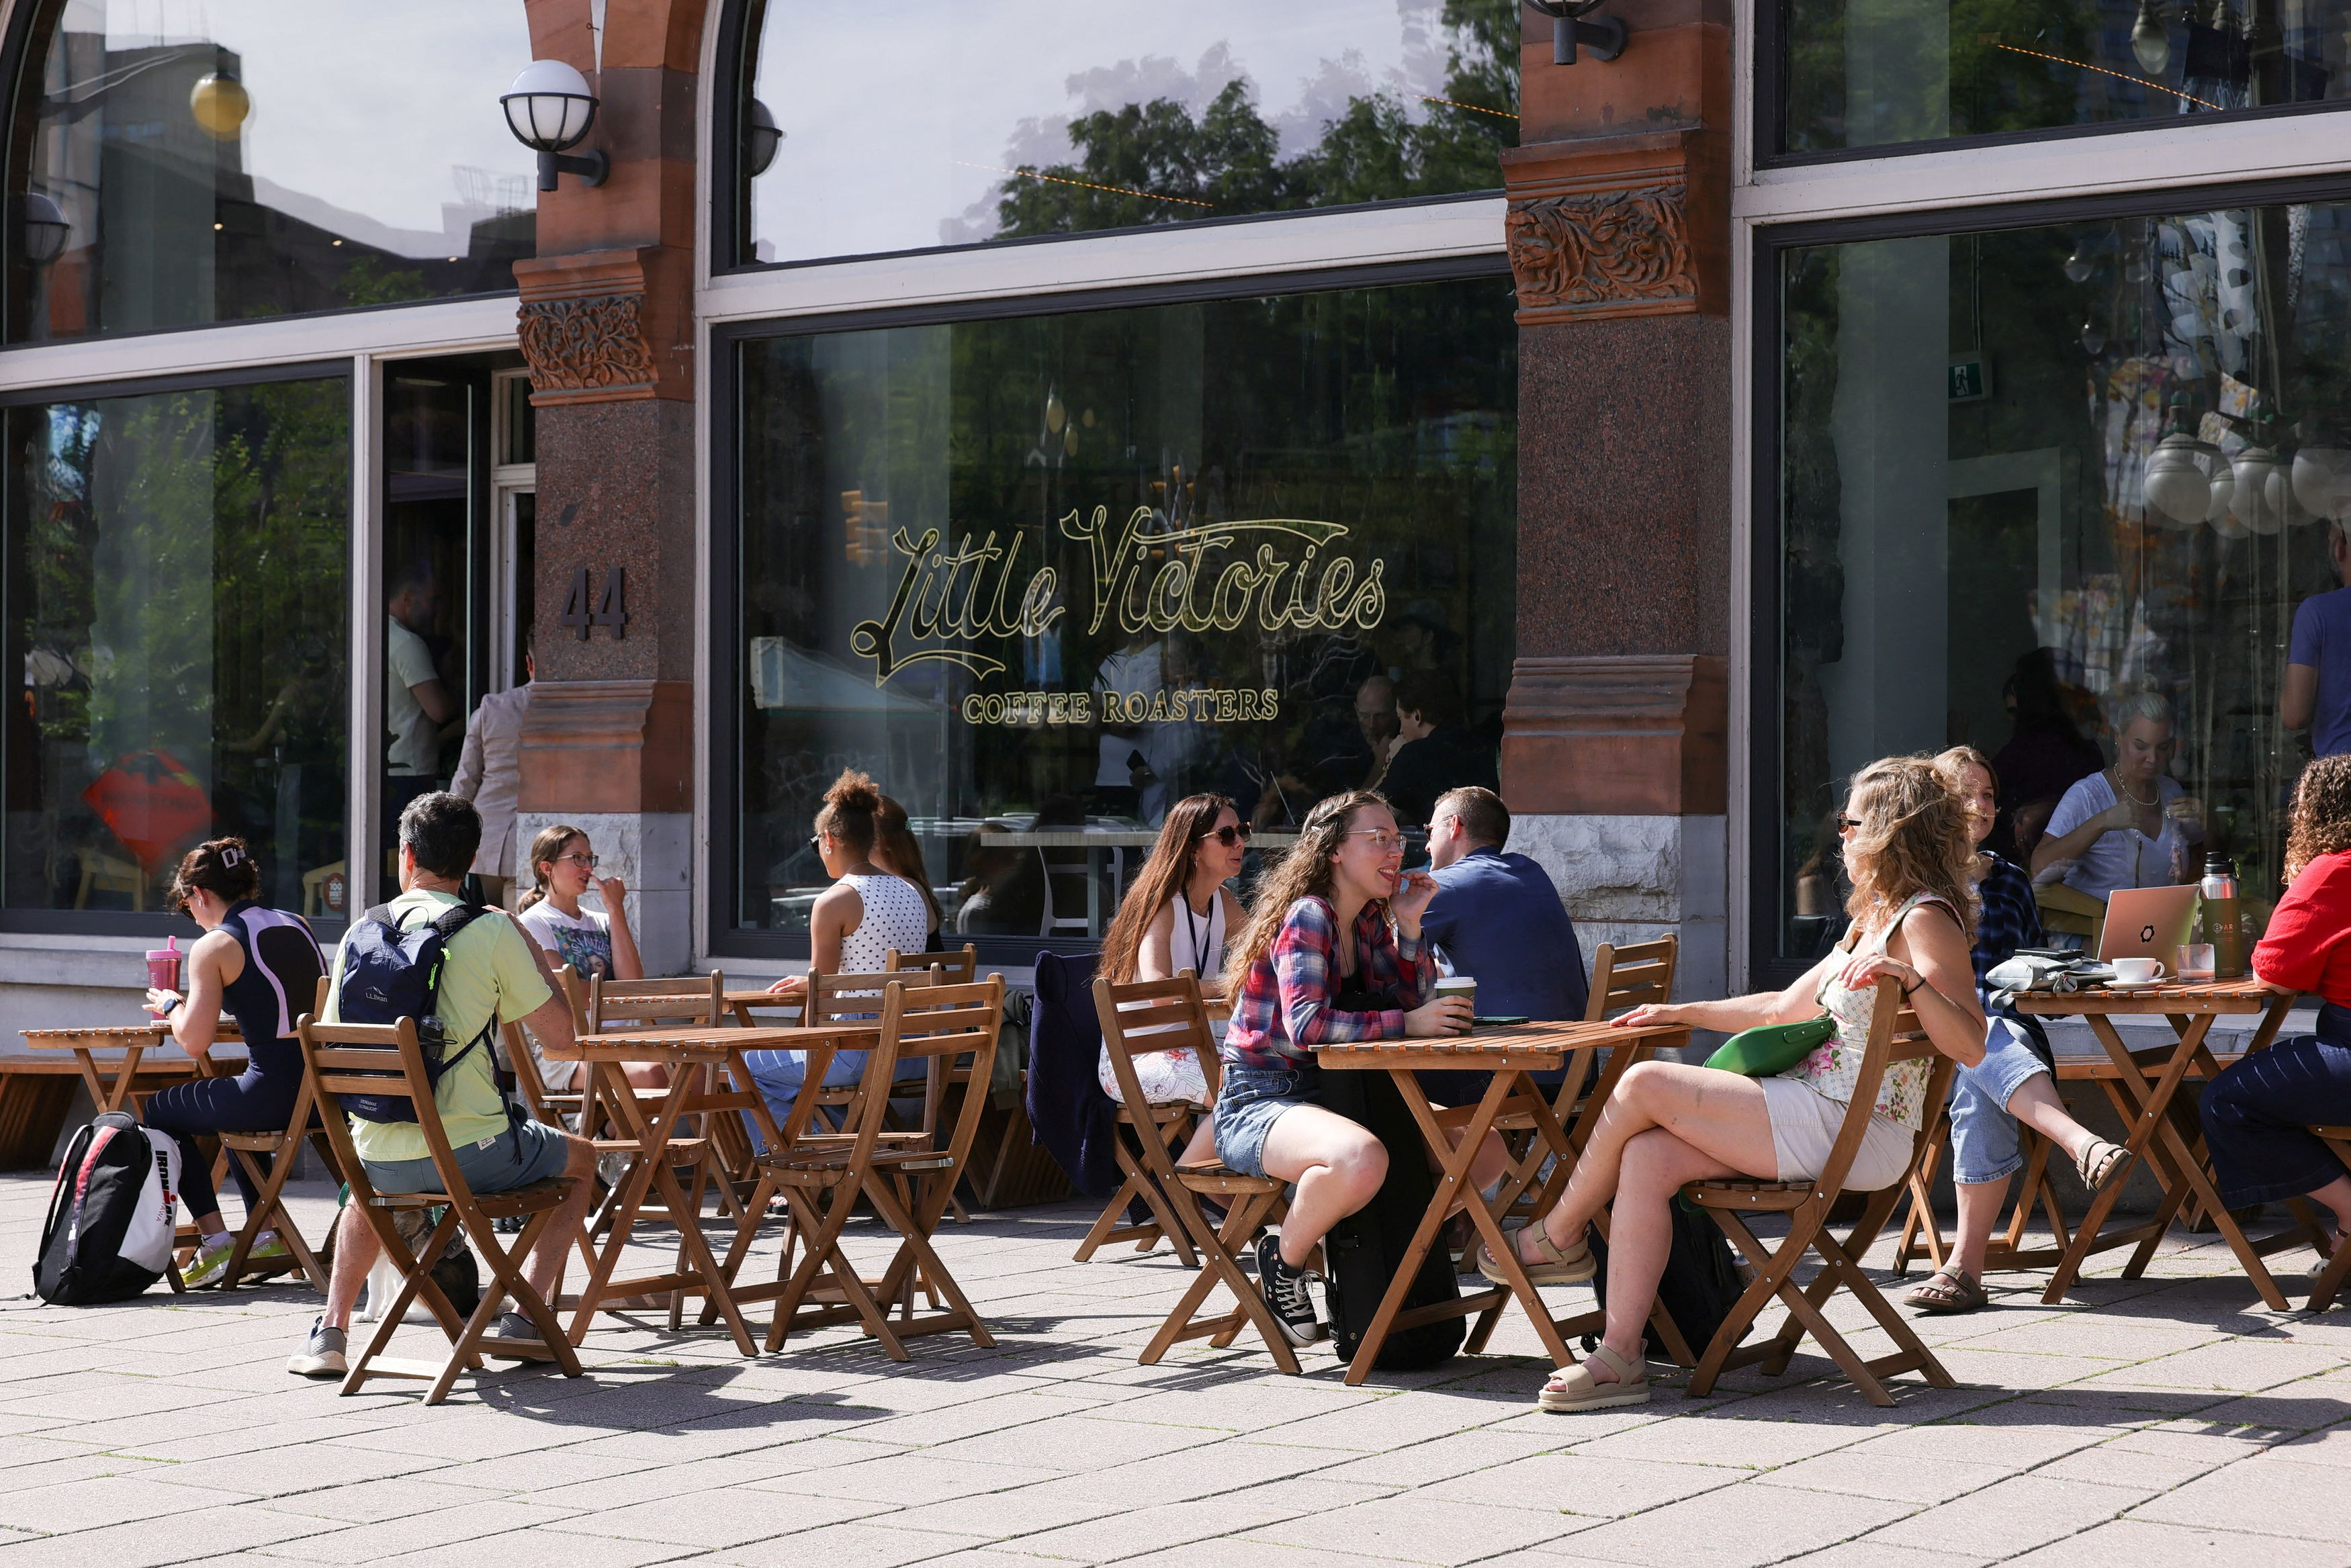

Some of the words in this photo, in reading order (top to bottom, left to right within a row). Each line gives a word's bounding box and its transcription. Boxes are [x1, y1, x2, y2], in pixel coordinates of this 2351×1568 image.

[560, 567, 626, 641] 44
[850, 524, 1066, 689] Little
[1059, 504, 1386, 635] Victories
[962, 690, 1092, 725] COFFEE
[1102, 688, 1279, 723] ROASTERS
[329, 882, 343, 891] 100
